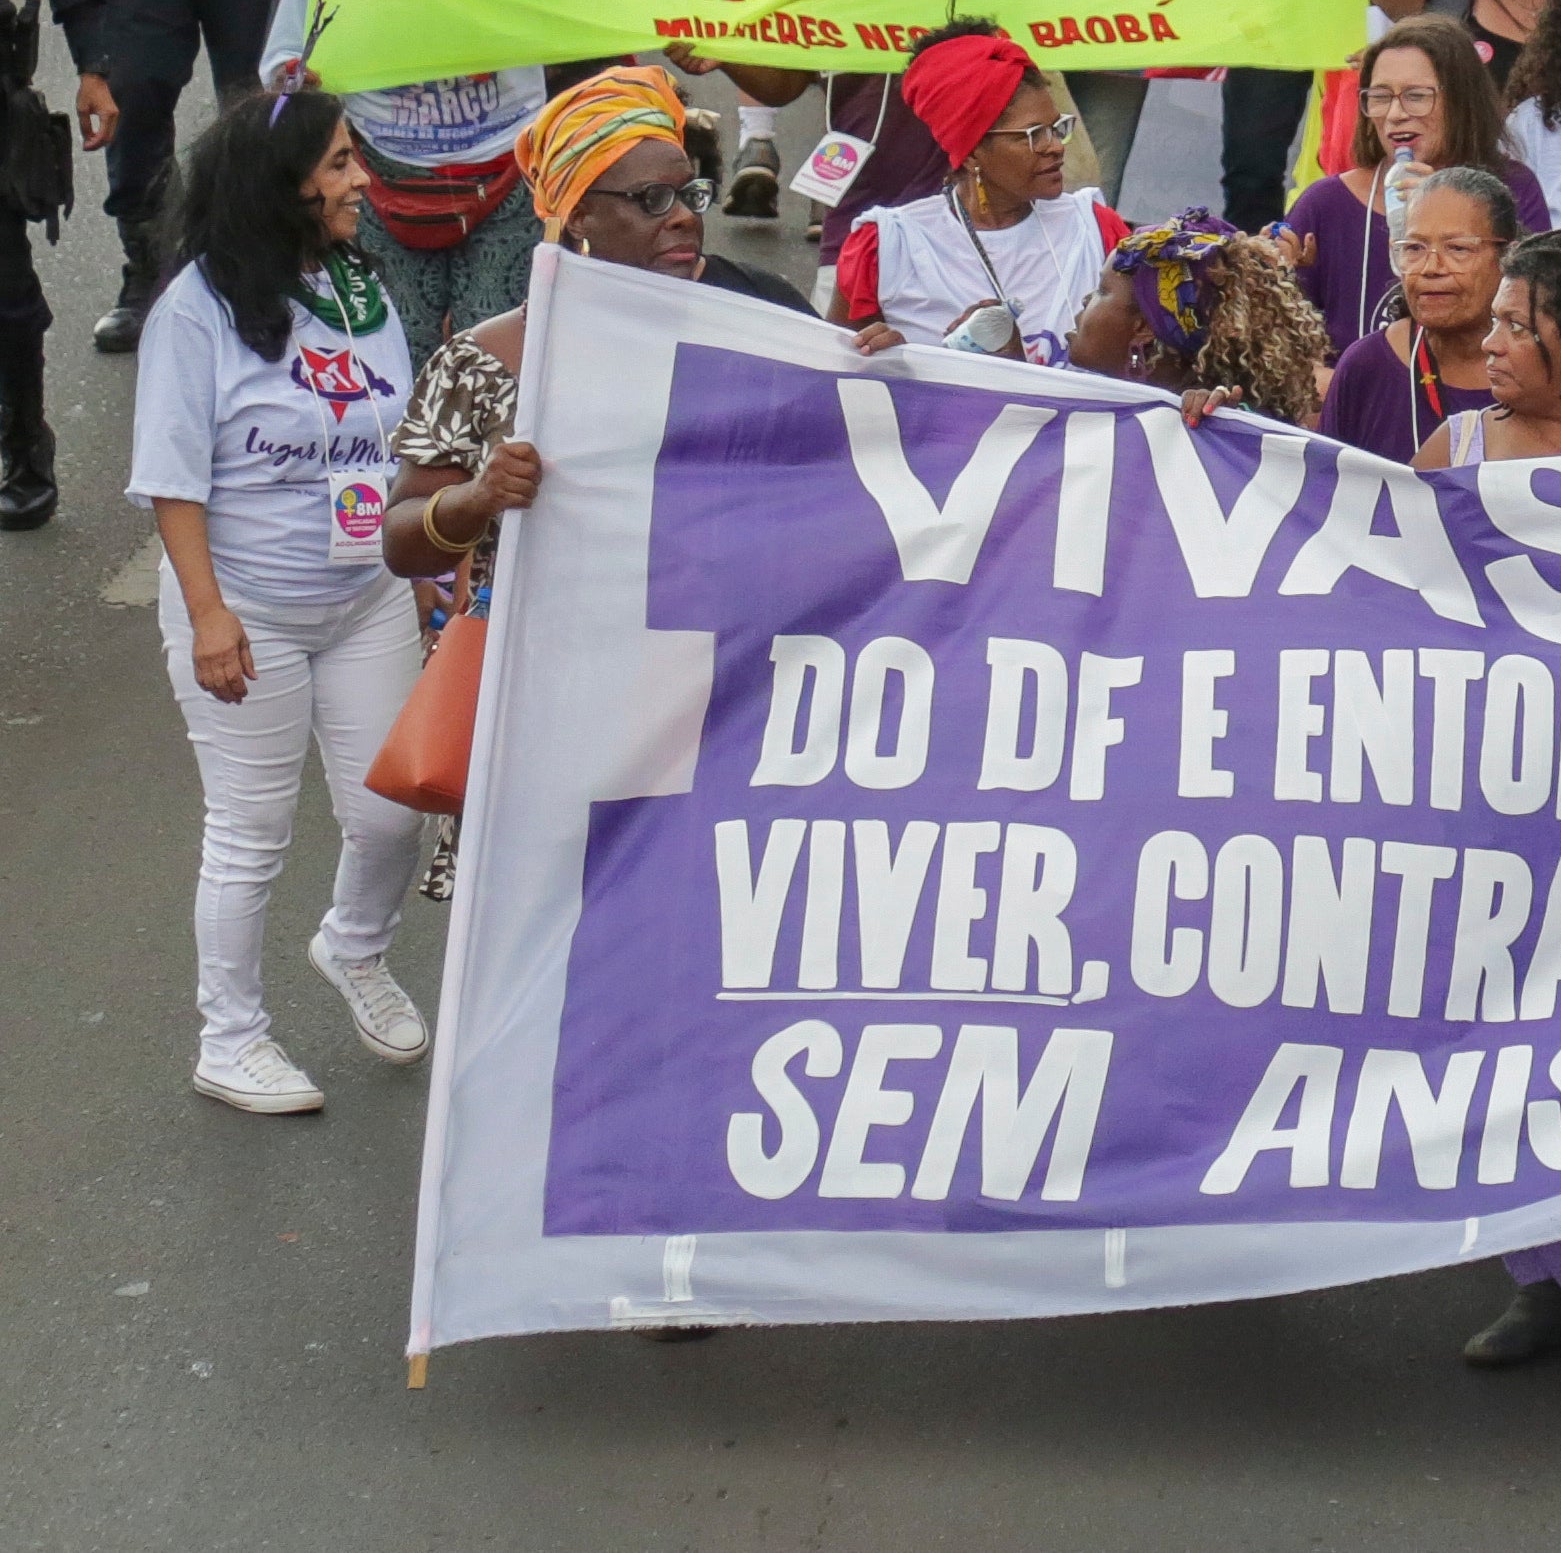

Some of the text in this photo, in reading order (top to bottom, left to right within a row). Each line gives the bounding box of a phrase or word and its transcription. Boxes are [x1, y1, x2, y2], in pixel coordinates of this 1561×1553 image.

[653, 11, 848, 51] MERES
[854, 23, 1013, 54] NEGS
[246, 426, 318, 467] Lugar
[355, 501, 382, 516] 8M
[749, 634, 935, 790] DO
[978, 636, 1144, 800] DF
[1177, 648, 1235, 800] E
[715, 817, 1110, 1004] VIVER,
[724, 1016, 1115, 1204] SEM
